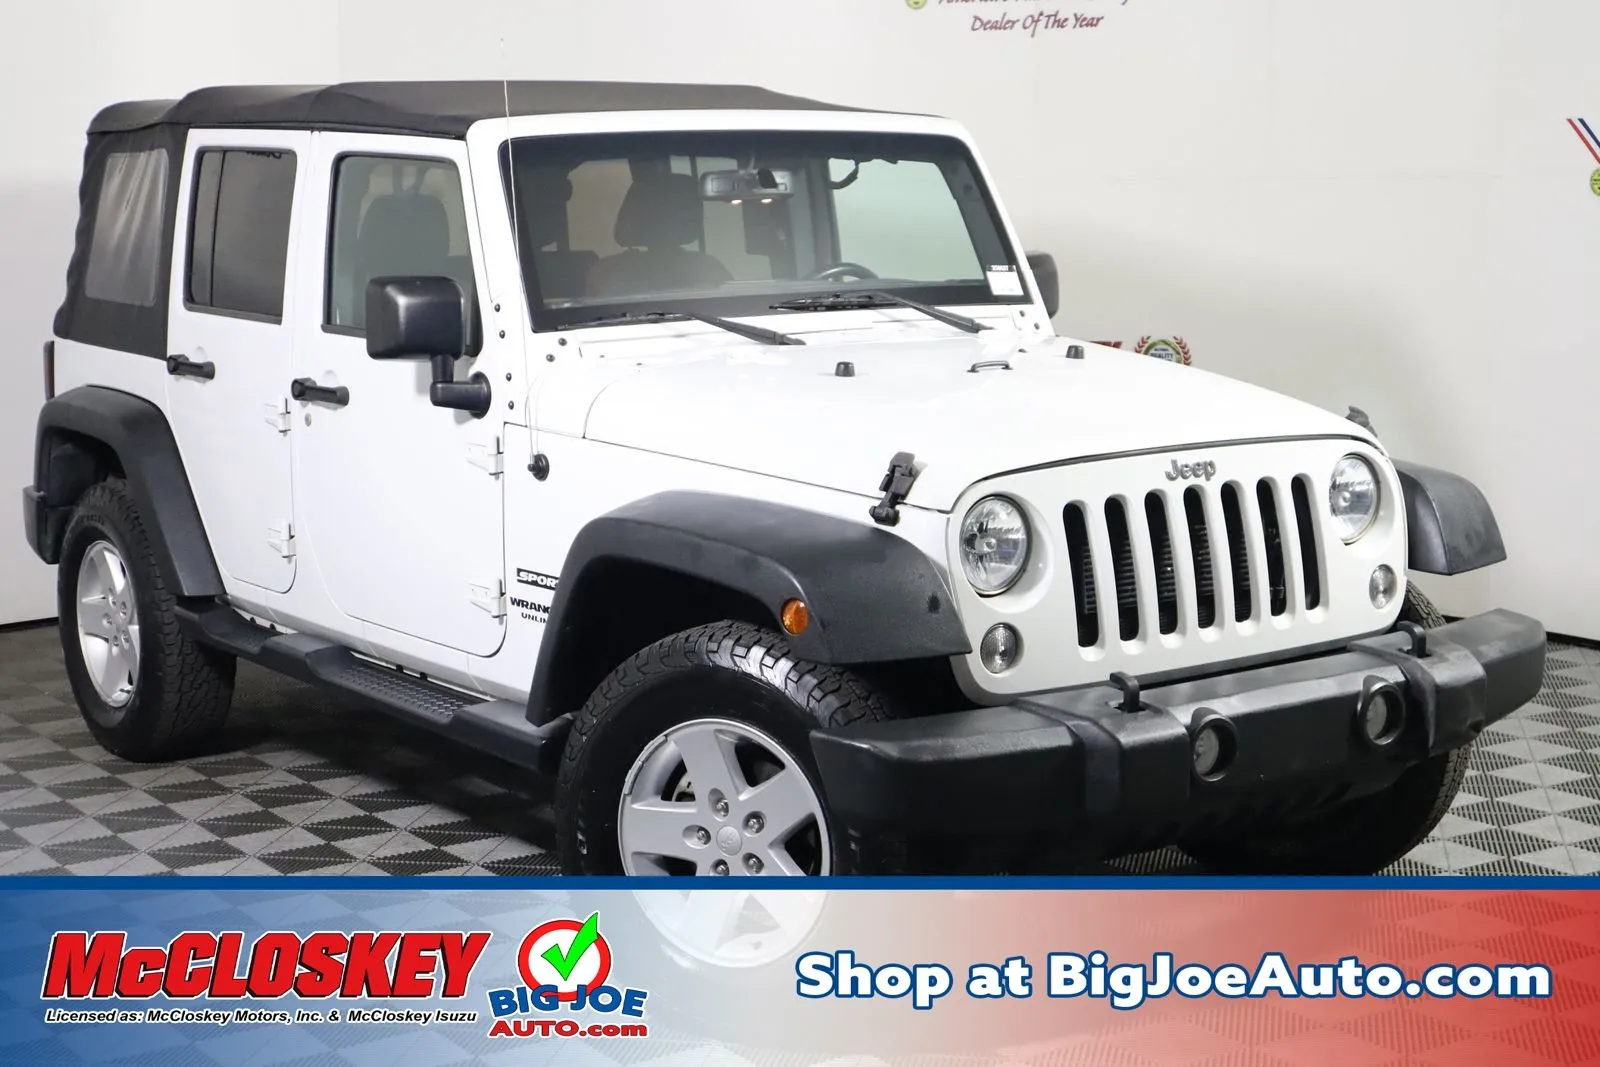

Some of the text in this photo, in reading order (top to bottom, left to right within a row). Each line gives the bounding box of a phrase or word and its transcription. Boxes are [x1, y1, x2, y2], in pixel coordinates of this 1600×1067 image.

[970, 10, 1105, 38] Dealer Of The Year
[1164, 459, 1217, 481] Jeep
